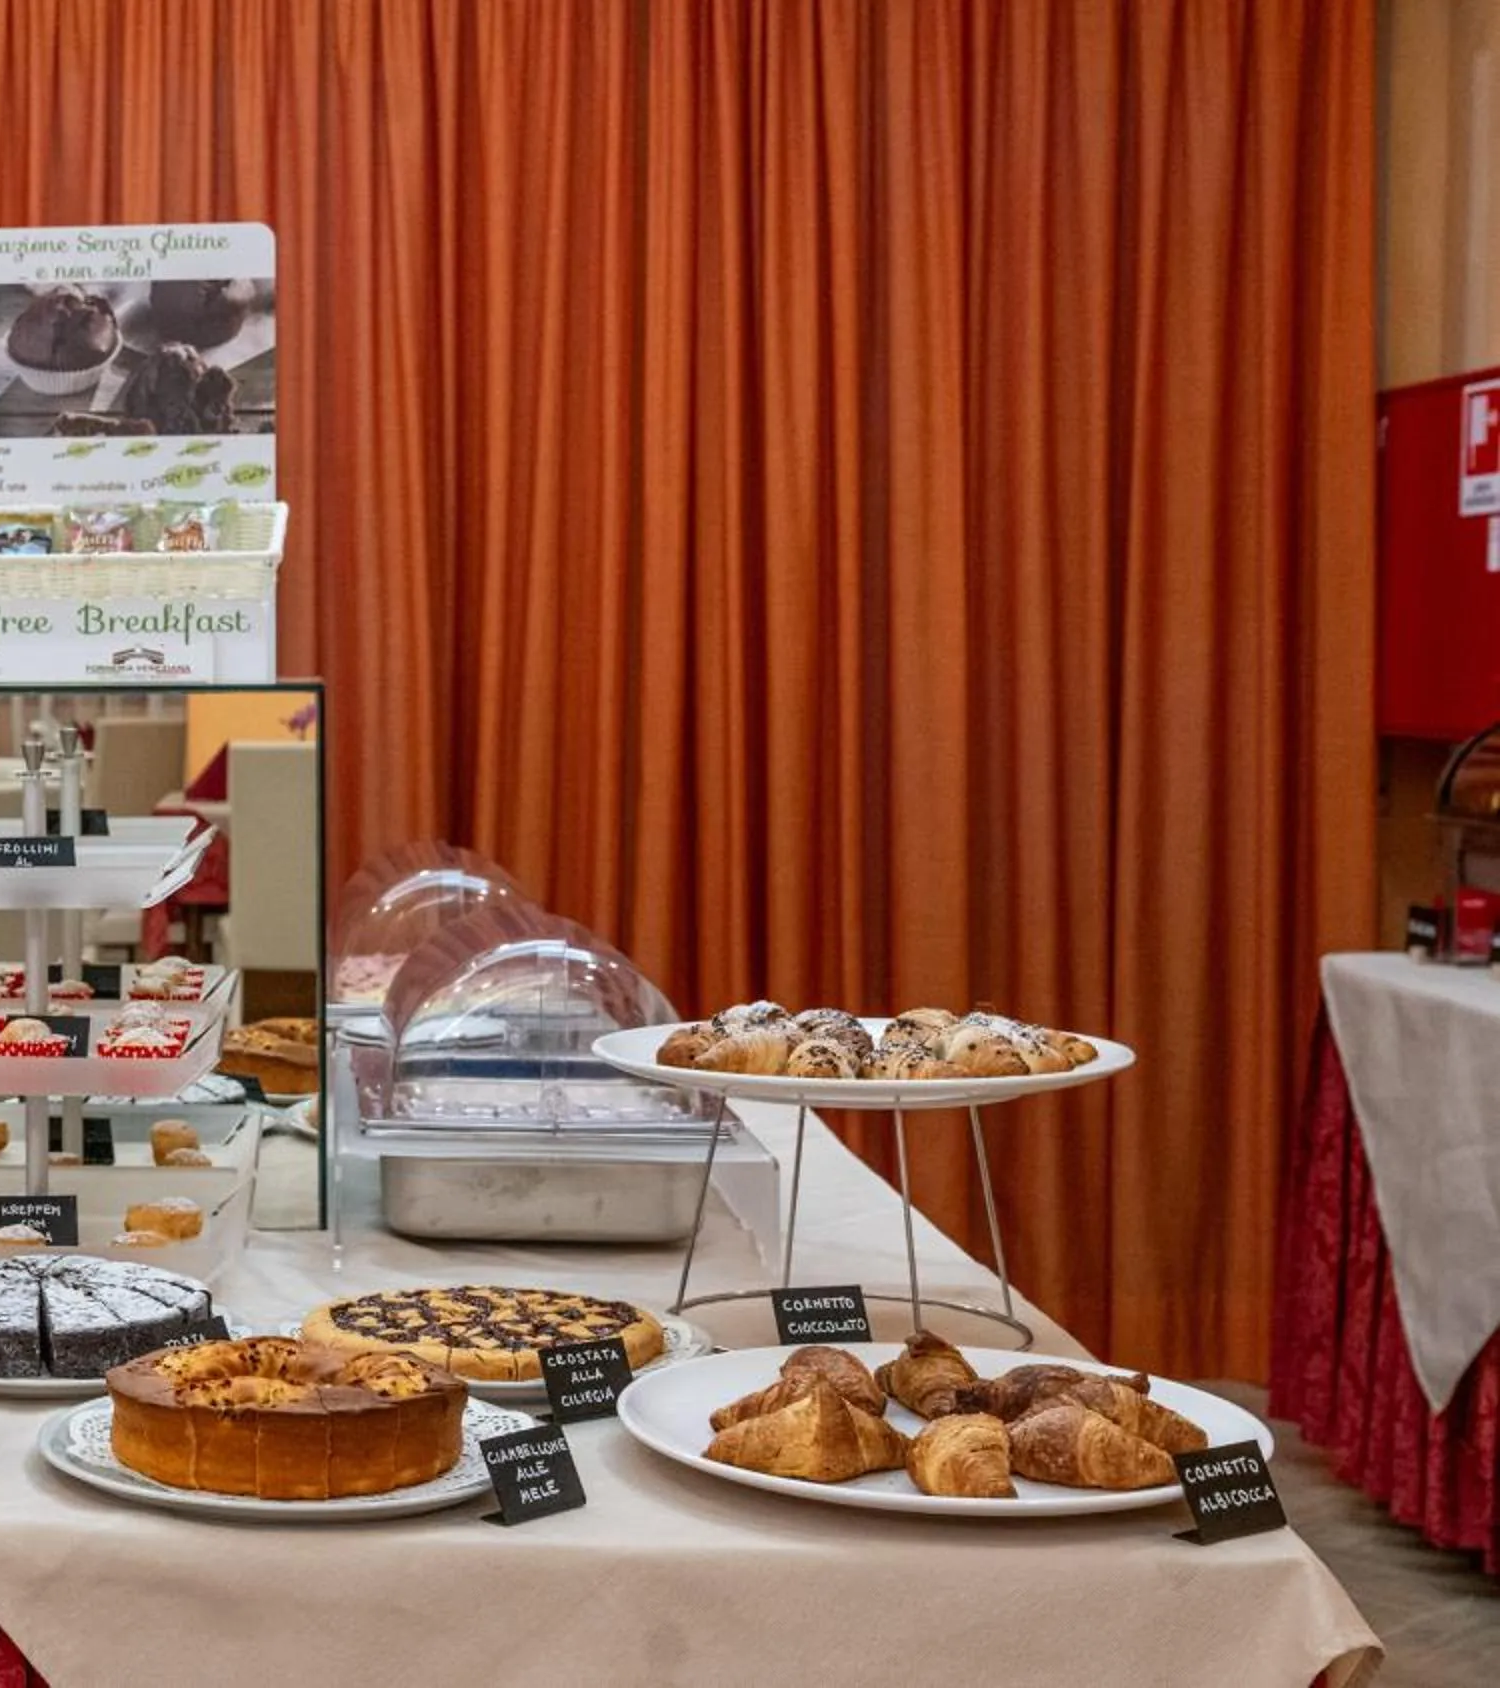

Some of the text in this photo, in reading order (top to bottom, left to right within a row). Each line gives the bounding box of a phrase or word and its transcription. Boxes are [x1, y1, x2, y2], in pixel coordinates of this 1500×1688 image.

[76, 231, 141, 262] Senza
[150, 229, 230, 259] Glutine
[55, 265, 94, 280] non
[76, 603, 251, 646] Breakfast
[782, 1296, 856, 1312] CORNETTO
[788, 1318, 867, 1335] CIOCCOLATO
[547, 1348, 620, 1367] CROSTATA
[571, 1367, 604, 1384] ALLA
[561, 1384, 615, 1407] CILIEGIA
[487, 1438, 569, 1465] CIAMBELLONE
[516, 1460, 550, 1482] ALLE
[1185, 1456, 1259, 1483] CORNETTO
[520, 1480, 560, 1505] MELE
[1200, 1485, 1276, 1514] ALBICOCCA
